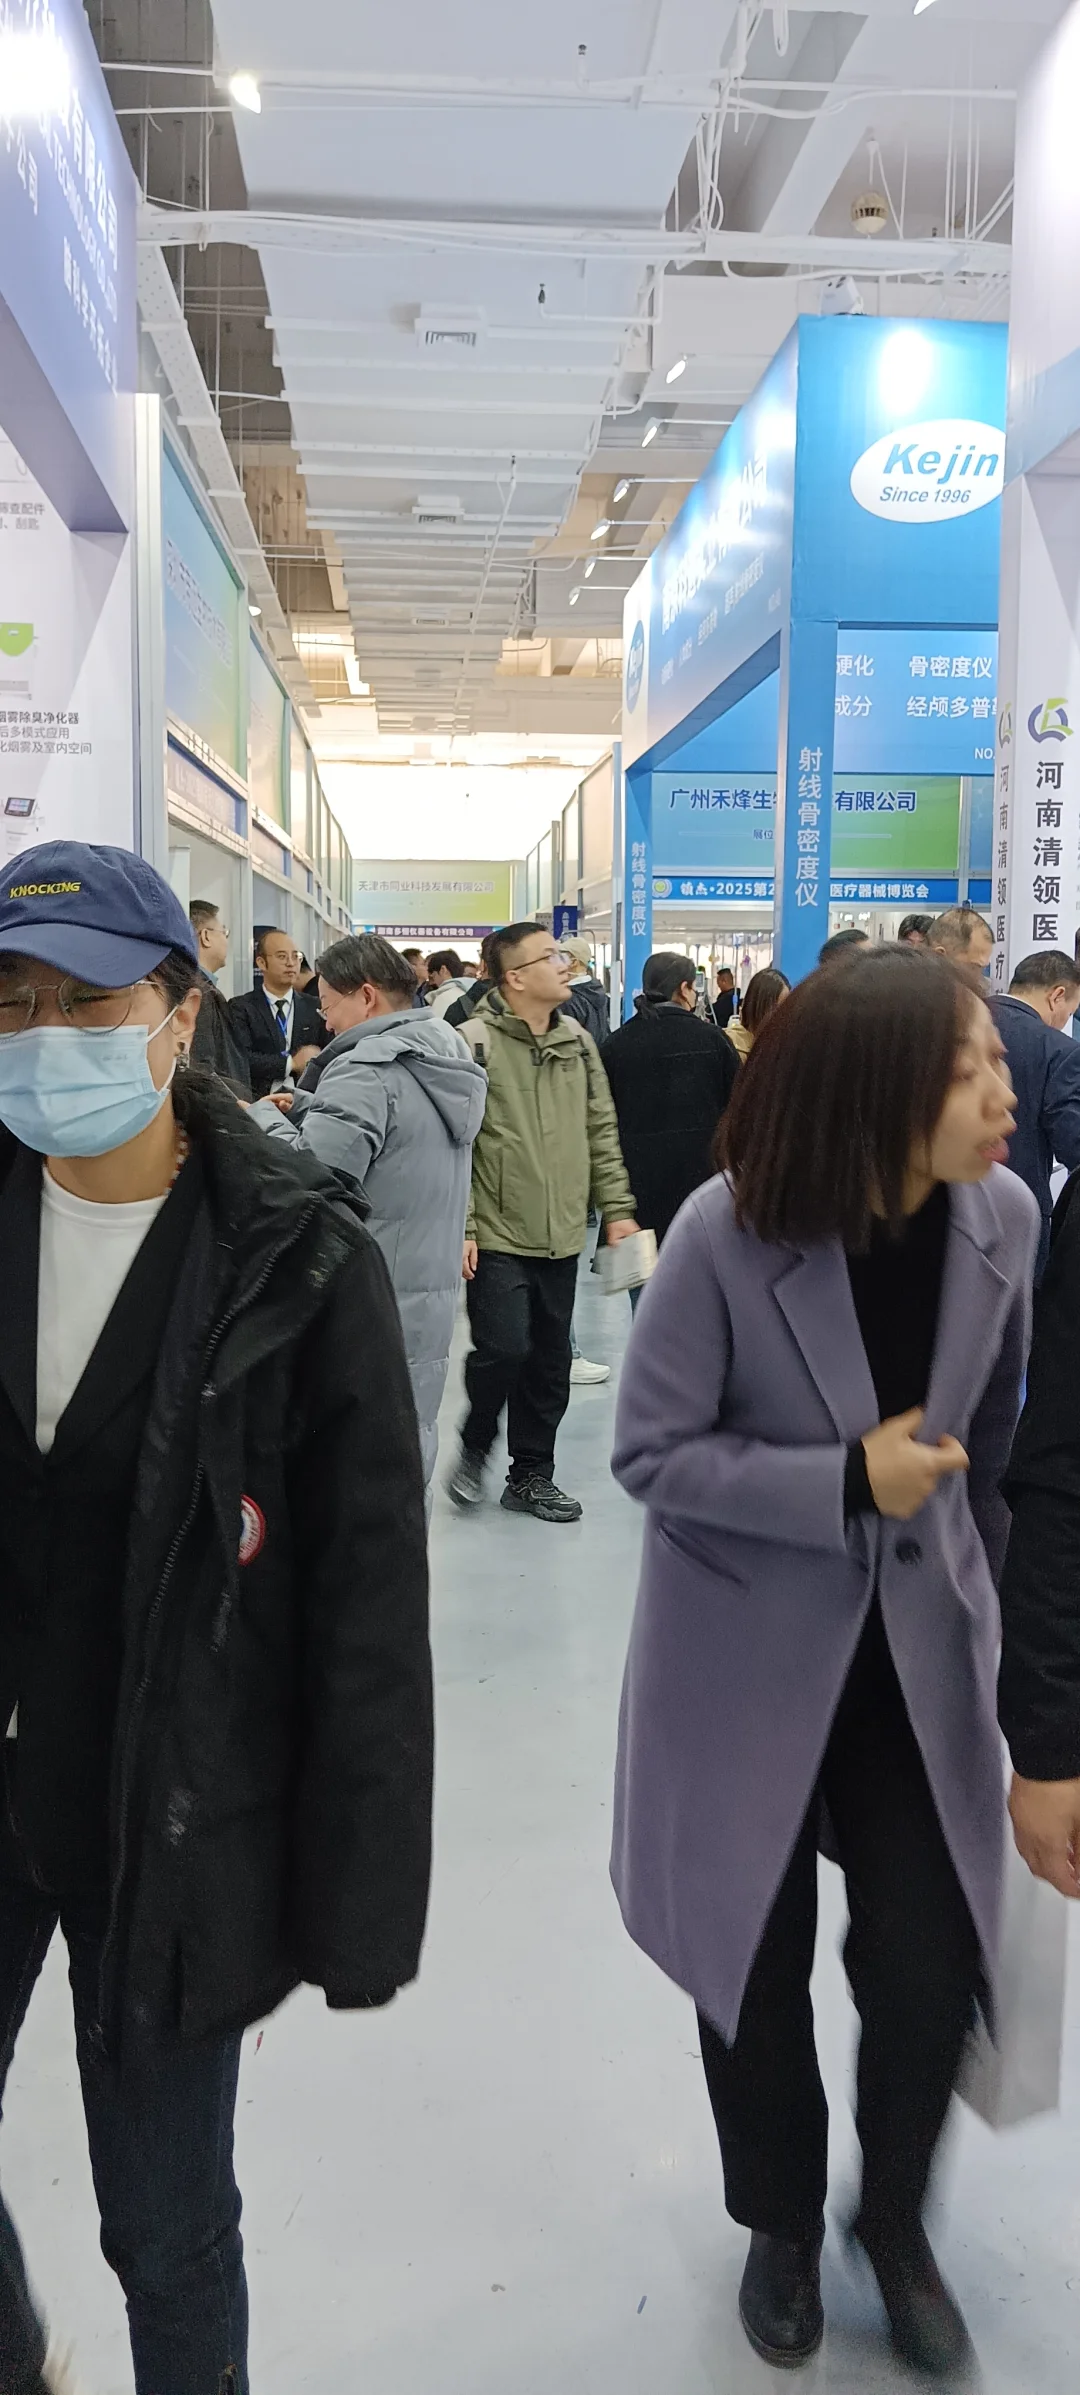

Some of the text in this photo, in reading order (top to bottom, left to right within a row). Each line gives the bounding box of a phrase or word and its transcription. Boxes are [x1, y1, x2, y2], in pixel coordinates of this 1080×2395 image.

[883, 444, 999, 484] Kejin
[879, 486, 971, 504] Since 1996
[909, 656, 993, 678] 骨密度仪
[795, 747, 823, 907] 射线骨密度仪
[1032, 761, 1064, 941] 河南清领医
[10, 882, 81, 899] KNOCKING
[631, 841, 646, 936] 射线骨密度仪
